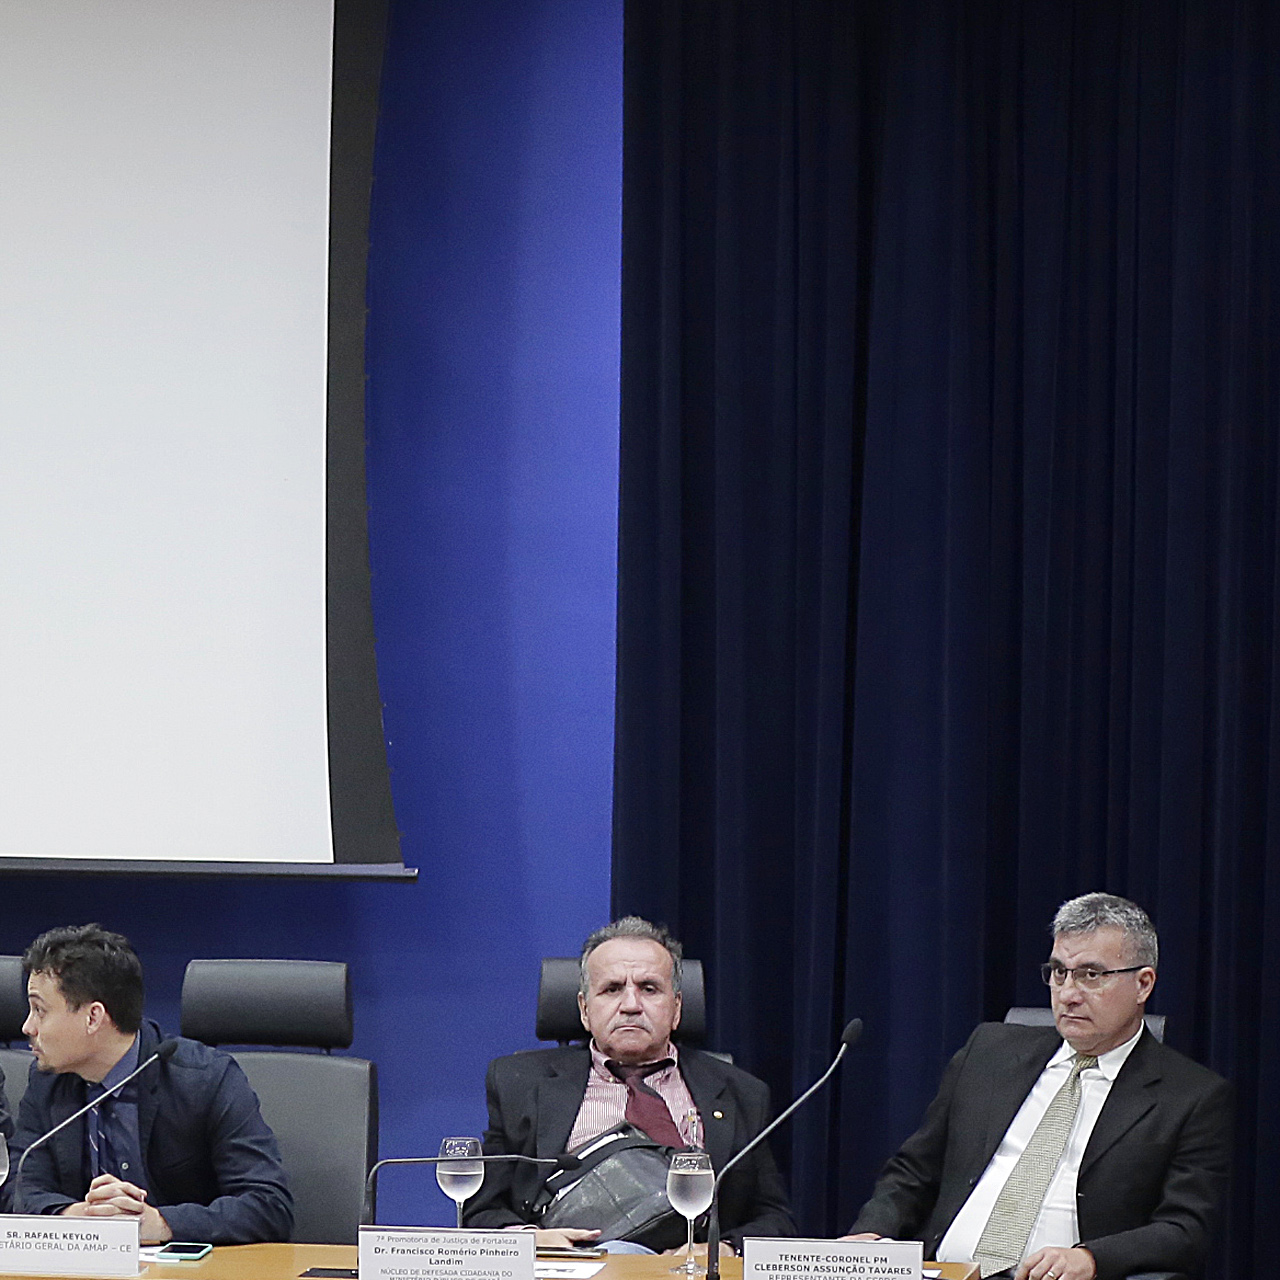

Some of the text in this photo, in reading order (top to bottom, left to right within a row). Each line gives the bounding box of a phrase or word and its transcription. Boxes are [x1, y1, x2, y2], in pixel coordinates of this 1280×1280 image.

[7, 1231, 99, 1241] SR. RAFAEL KEYLON
[442, 1237, 468, 1245] Justiça
[35, 1242, 64, 1251] GERAL
[83, 1244, 108, 1252] AMAP
[120, 1245, 132, 1253] CE
[391, 1247, 435, 1255] Francisco
[438, 1248, 477, 1256] Romério
[480, 1249, 519, 1257] Pinheiro
[429, 1258, 463, 1266] Landim
[779, 1254, 870, 1264] TENENTE-CORONEL
[755, 1264, 912, 1275] CLEBERSON ASSUNÇÃO TAVARES
